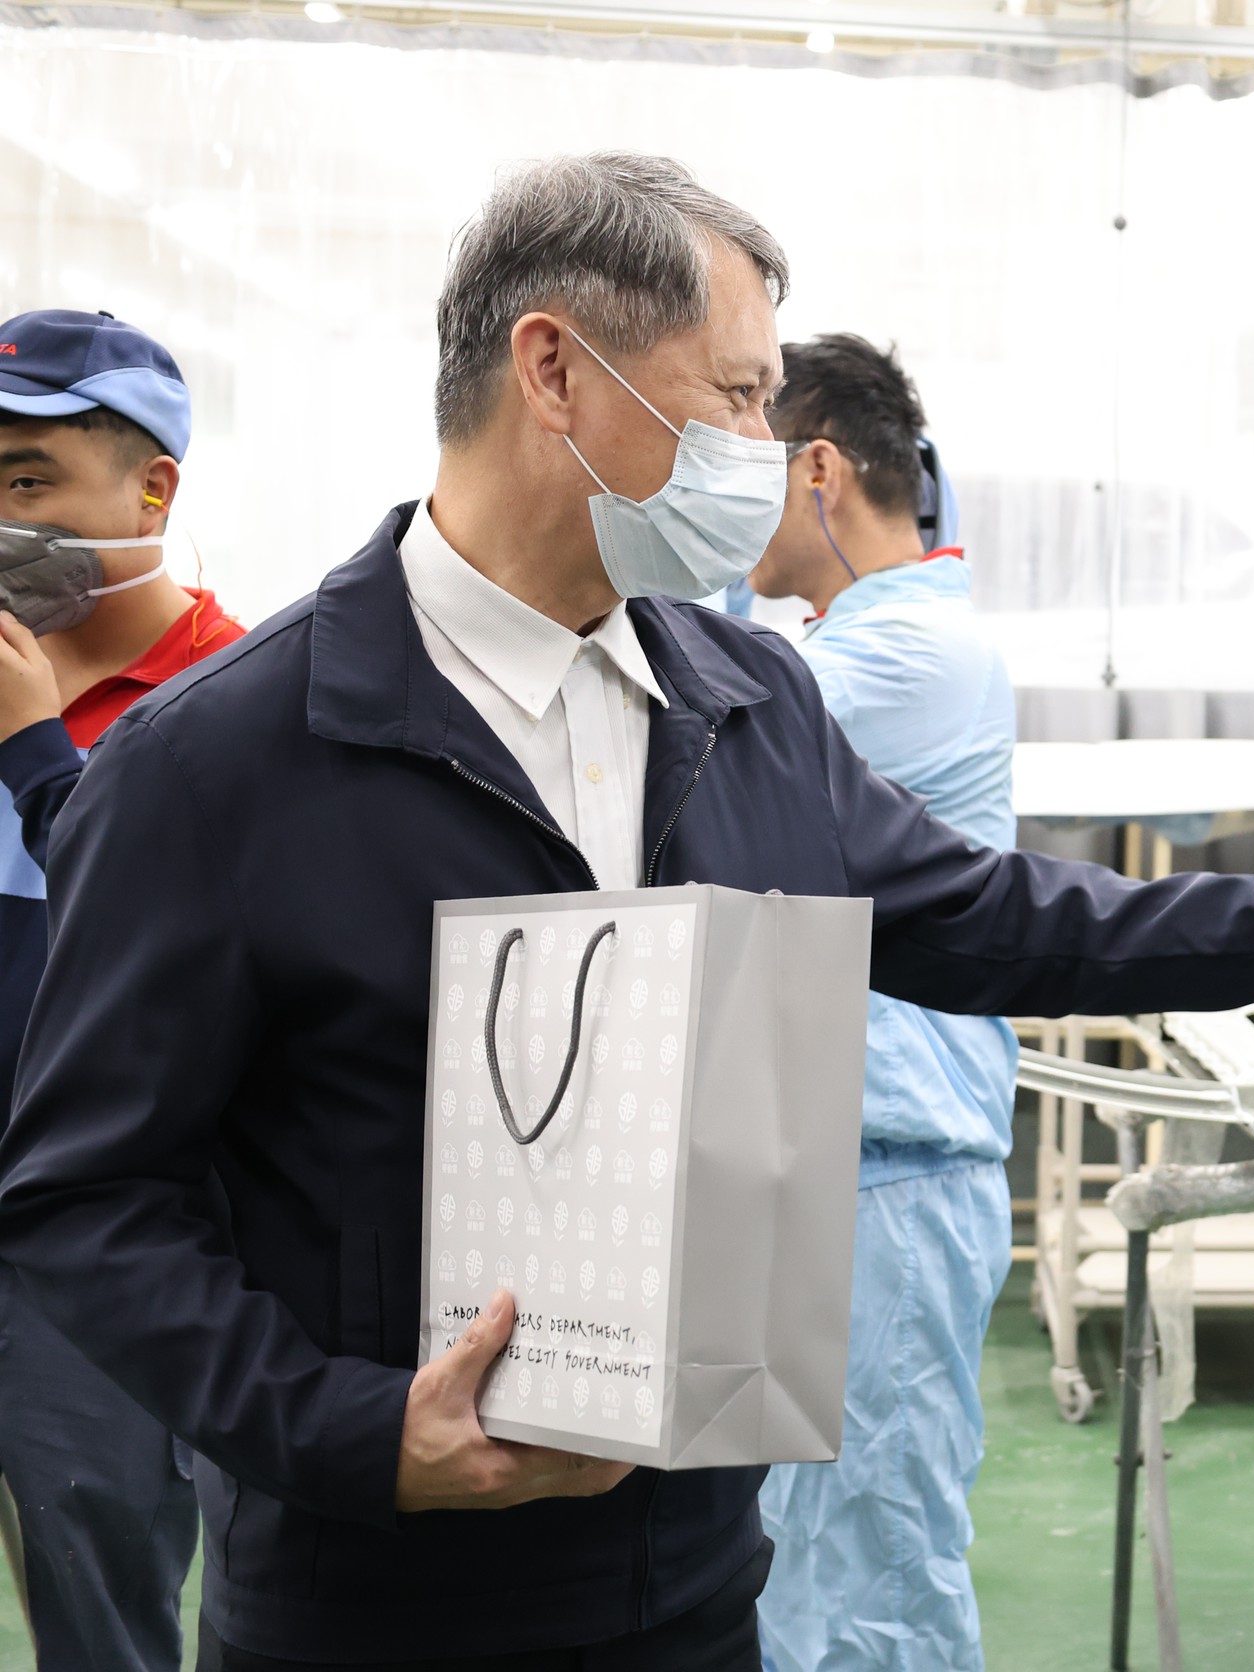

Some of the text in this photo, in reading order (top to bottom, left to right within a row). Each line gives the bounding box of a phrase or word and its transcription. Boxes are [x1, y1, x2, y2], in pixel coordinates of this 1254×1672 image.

[444, 1306, 635, 1344] LABOR AIRS DEPARTMENT,
[527, 1347, 558, 1369] CITY
[565, 1350, 651, 1380] GOVERNMENT
